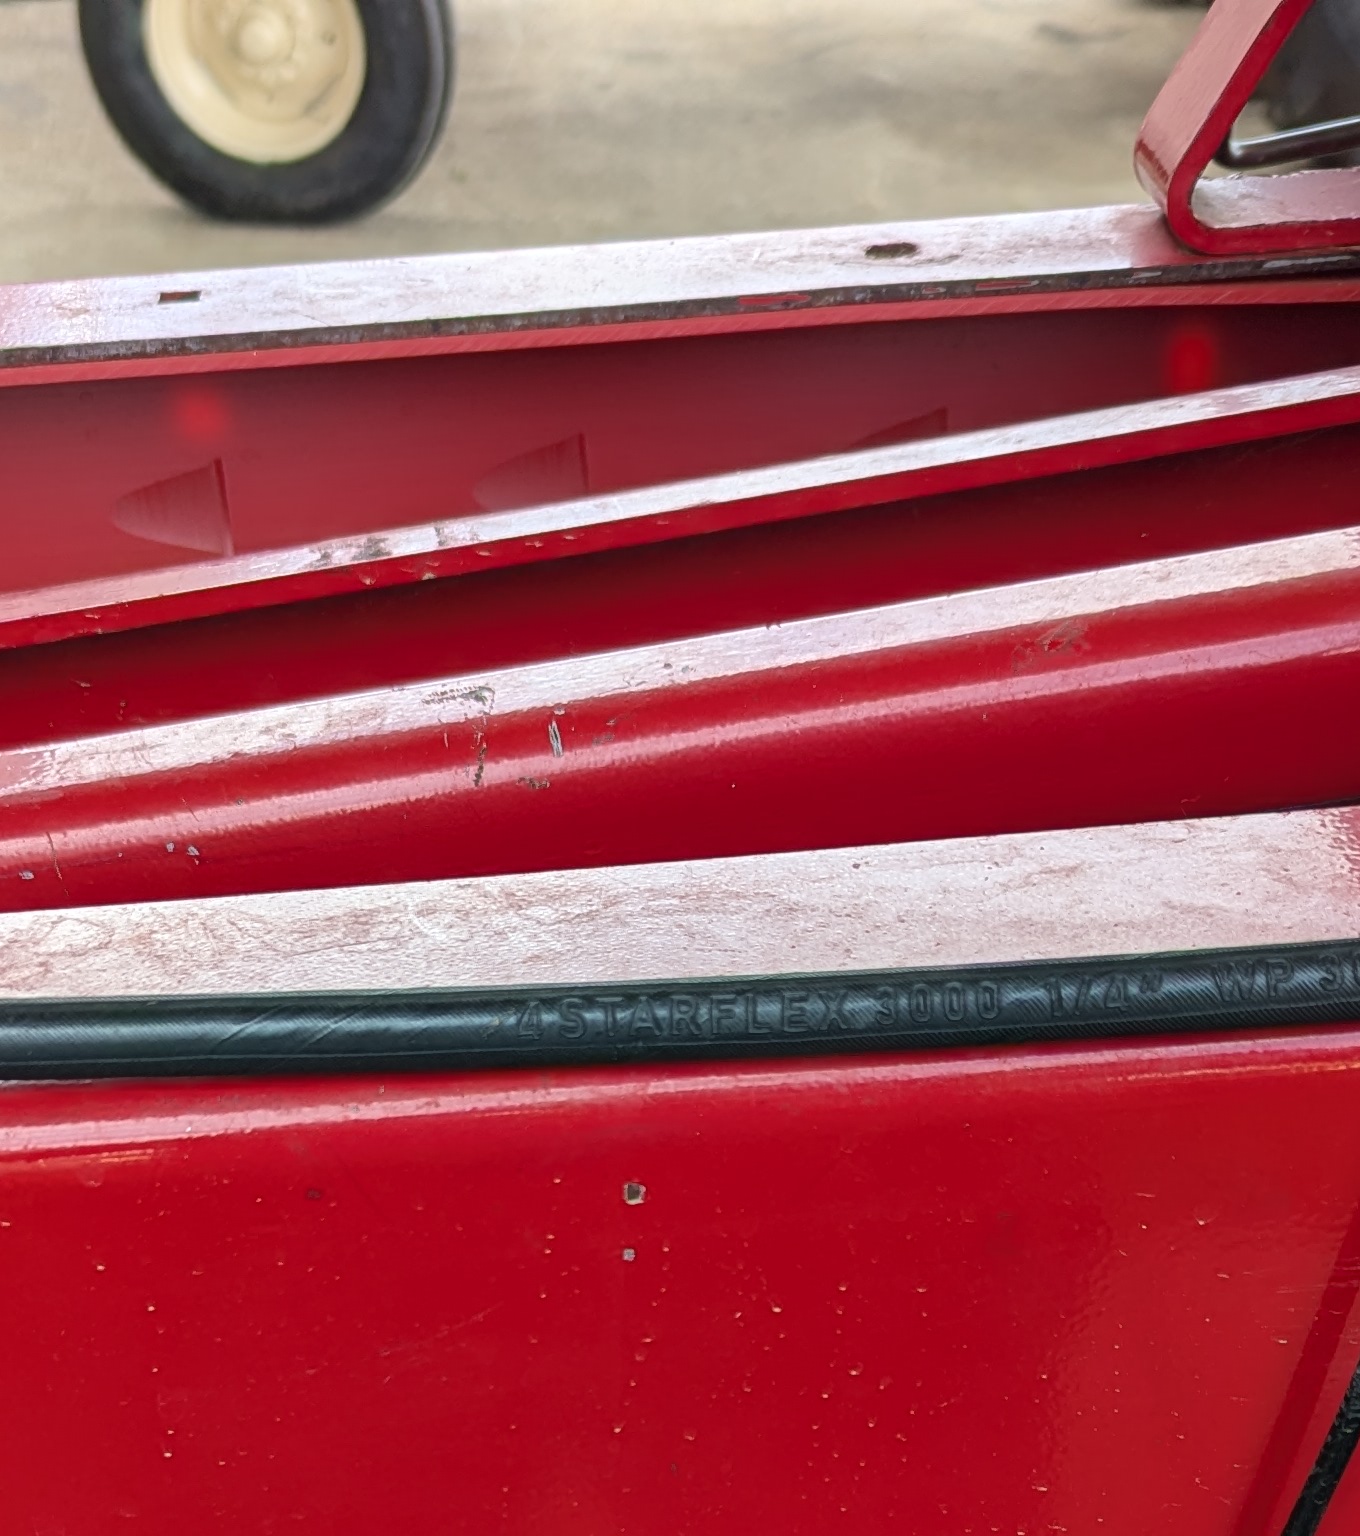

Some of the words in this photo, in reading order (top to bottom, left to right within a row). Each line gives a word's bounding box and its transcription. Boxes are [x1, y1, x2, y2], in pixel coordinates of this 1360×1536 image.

[517, 989, 849, 1040] 4STARFLEX
[873, 979, 1001, 1026] 3000
[1045, 970, 1165, 1018] 1/4"
[1213, 957, 1295, 1002] WP
